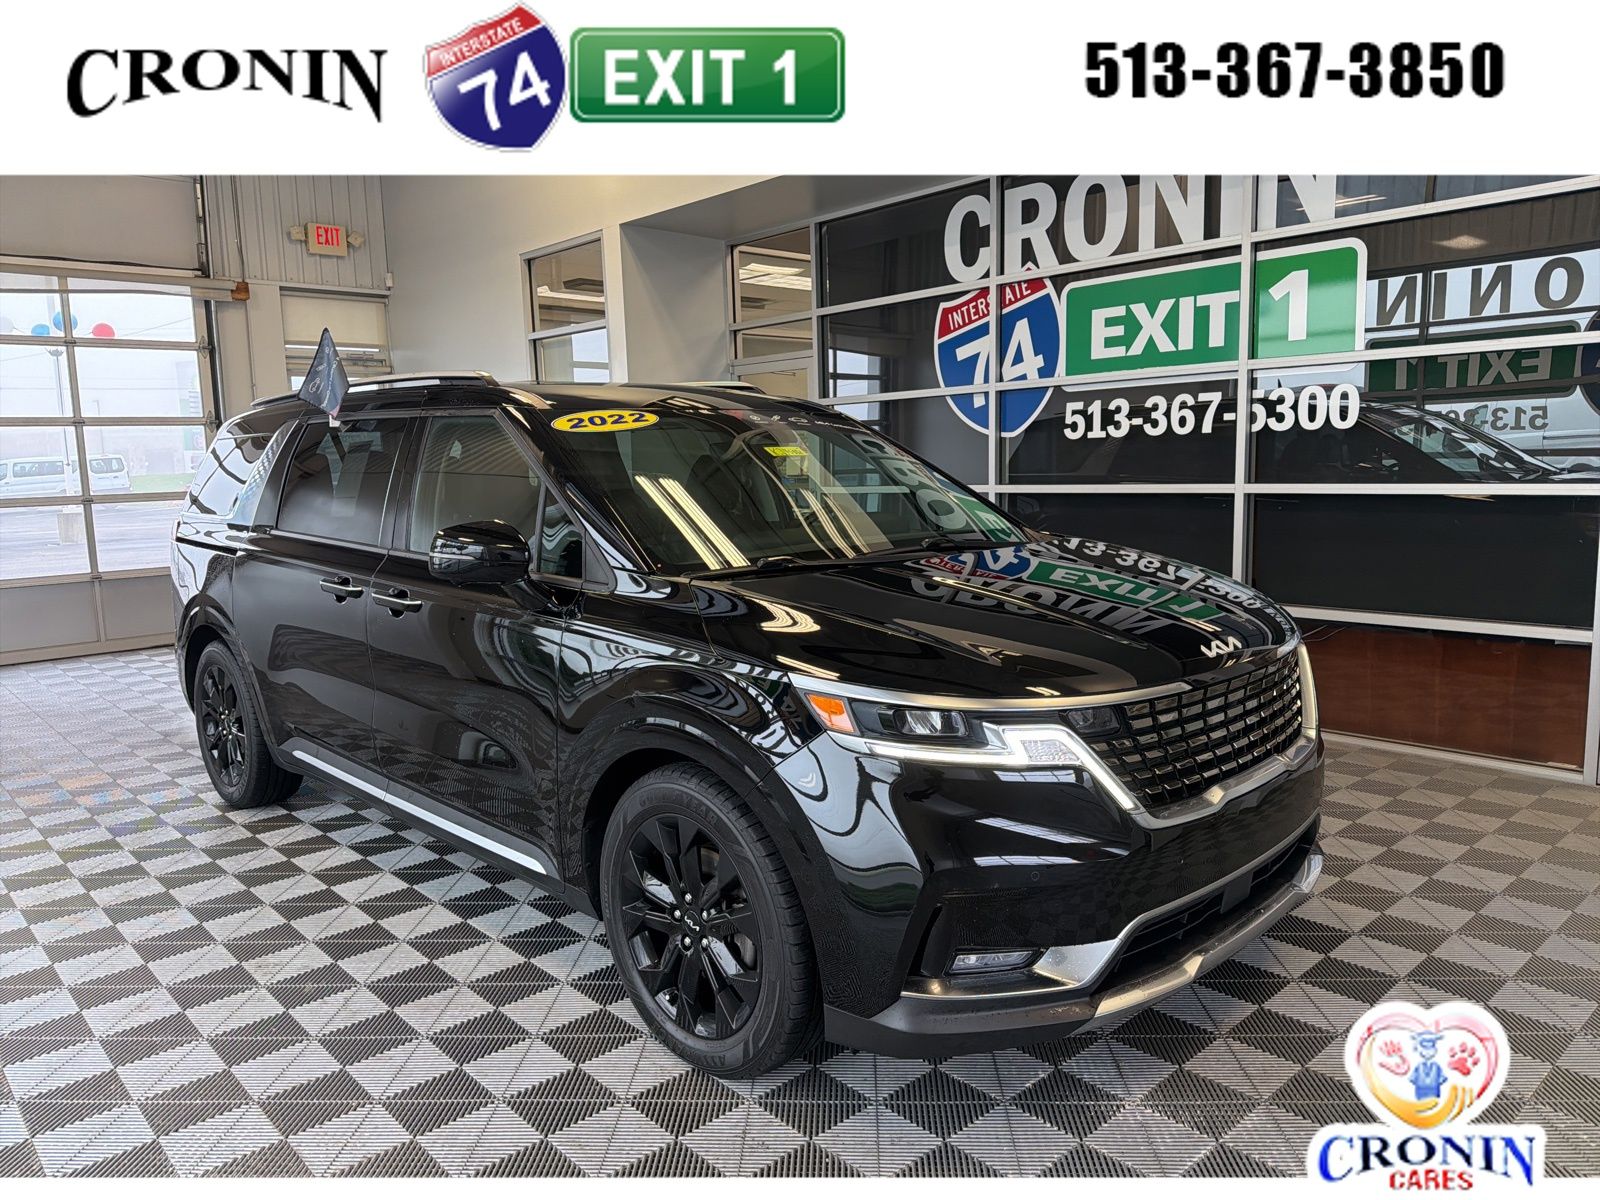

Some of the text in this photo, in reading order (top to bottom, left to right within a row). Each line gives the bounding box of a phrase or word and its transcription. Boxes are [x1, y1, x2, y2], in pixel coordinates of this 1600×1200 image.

[316, 224, 340, 247] EXIT
[944, 175, 1336, 283] CRONIN
[949, 281, 1031, 331] INTERSATE
[1090, 269, 1309, 361] EXIT 1
[955, 317, 1045, 408] 74
[566, 412, 651, 430] 2022
